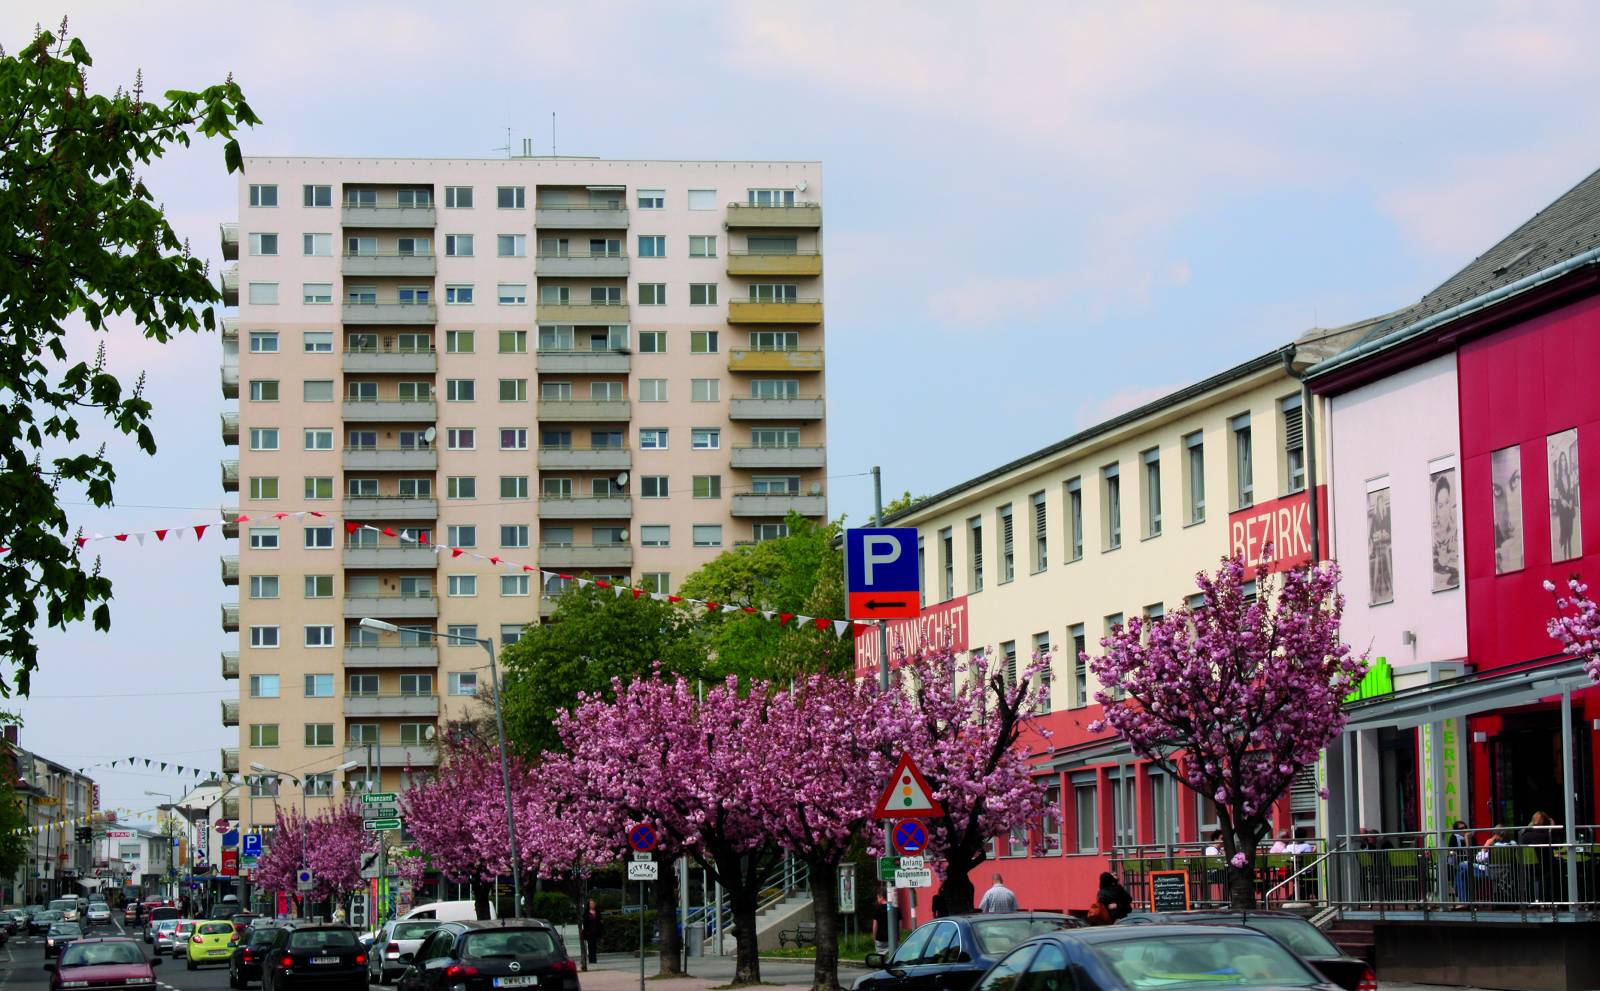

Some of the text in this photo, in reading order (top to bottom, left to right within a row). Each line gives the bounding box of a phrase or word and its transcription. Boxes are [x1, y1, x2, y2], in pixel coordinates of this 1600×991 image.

[863, 534, 902, 586] P
[857, 605, 965, 669] HAUTMANNSCHAFT
[365, 795, 393, 803] Finanzamt
[247, 836, 257, 849] P
[903, 859, 923, 867] Anfang
[897, 871, 930, 879] Ausgenommen
[909, 879, 919, 887] Taxi
